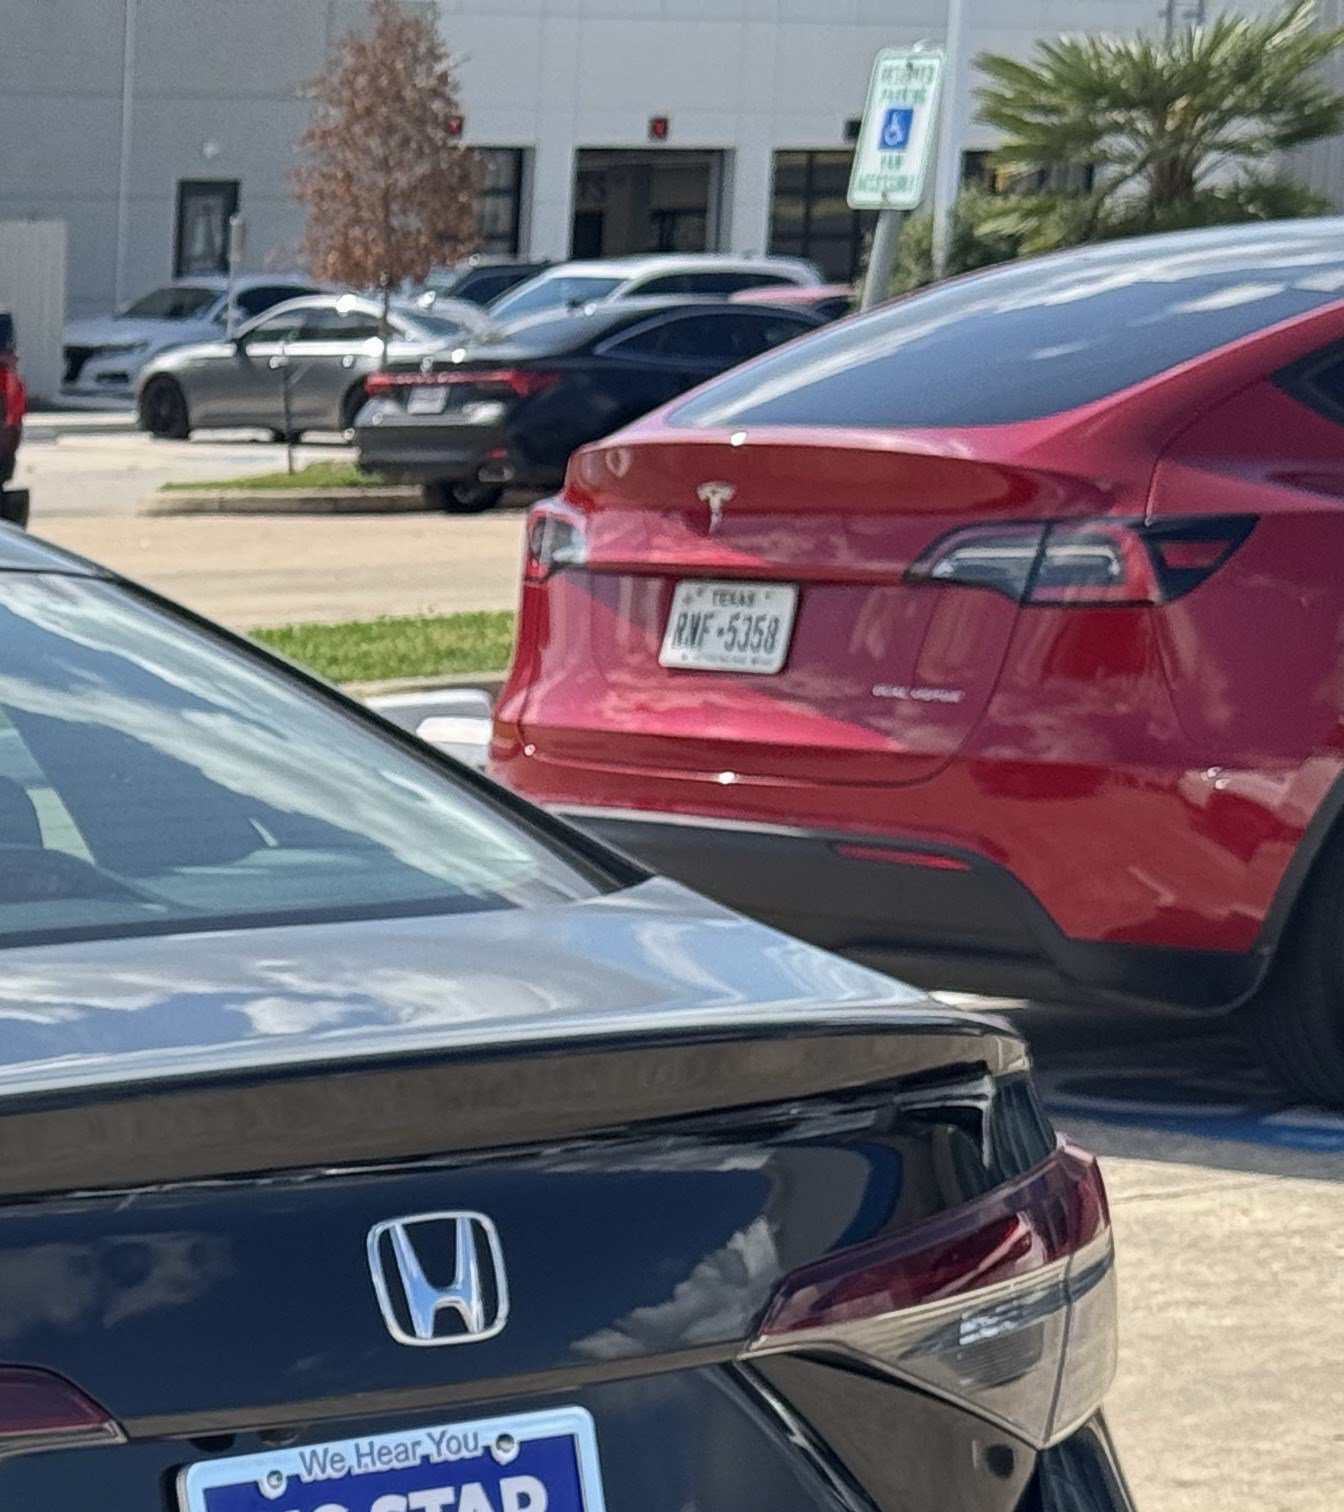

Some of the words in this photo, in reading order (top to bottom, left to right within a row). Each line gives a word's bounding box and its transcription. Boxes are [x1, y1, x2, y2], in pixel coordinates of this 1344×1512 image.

[298, 1447, 347, 1477] We
[353, 1439, 422, 1470] Hear
[426, 1429, 480, 1458] You
